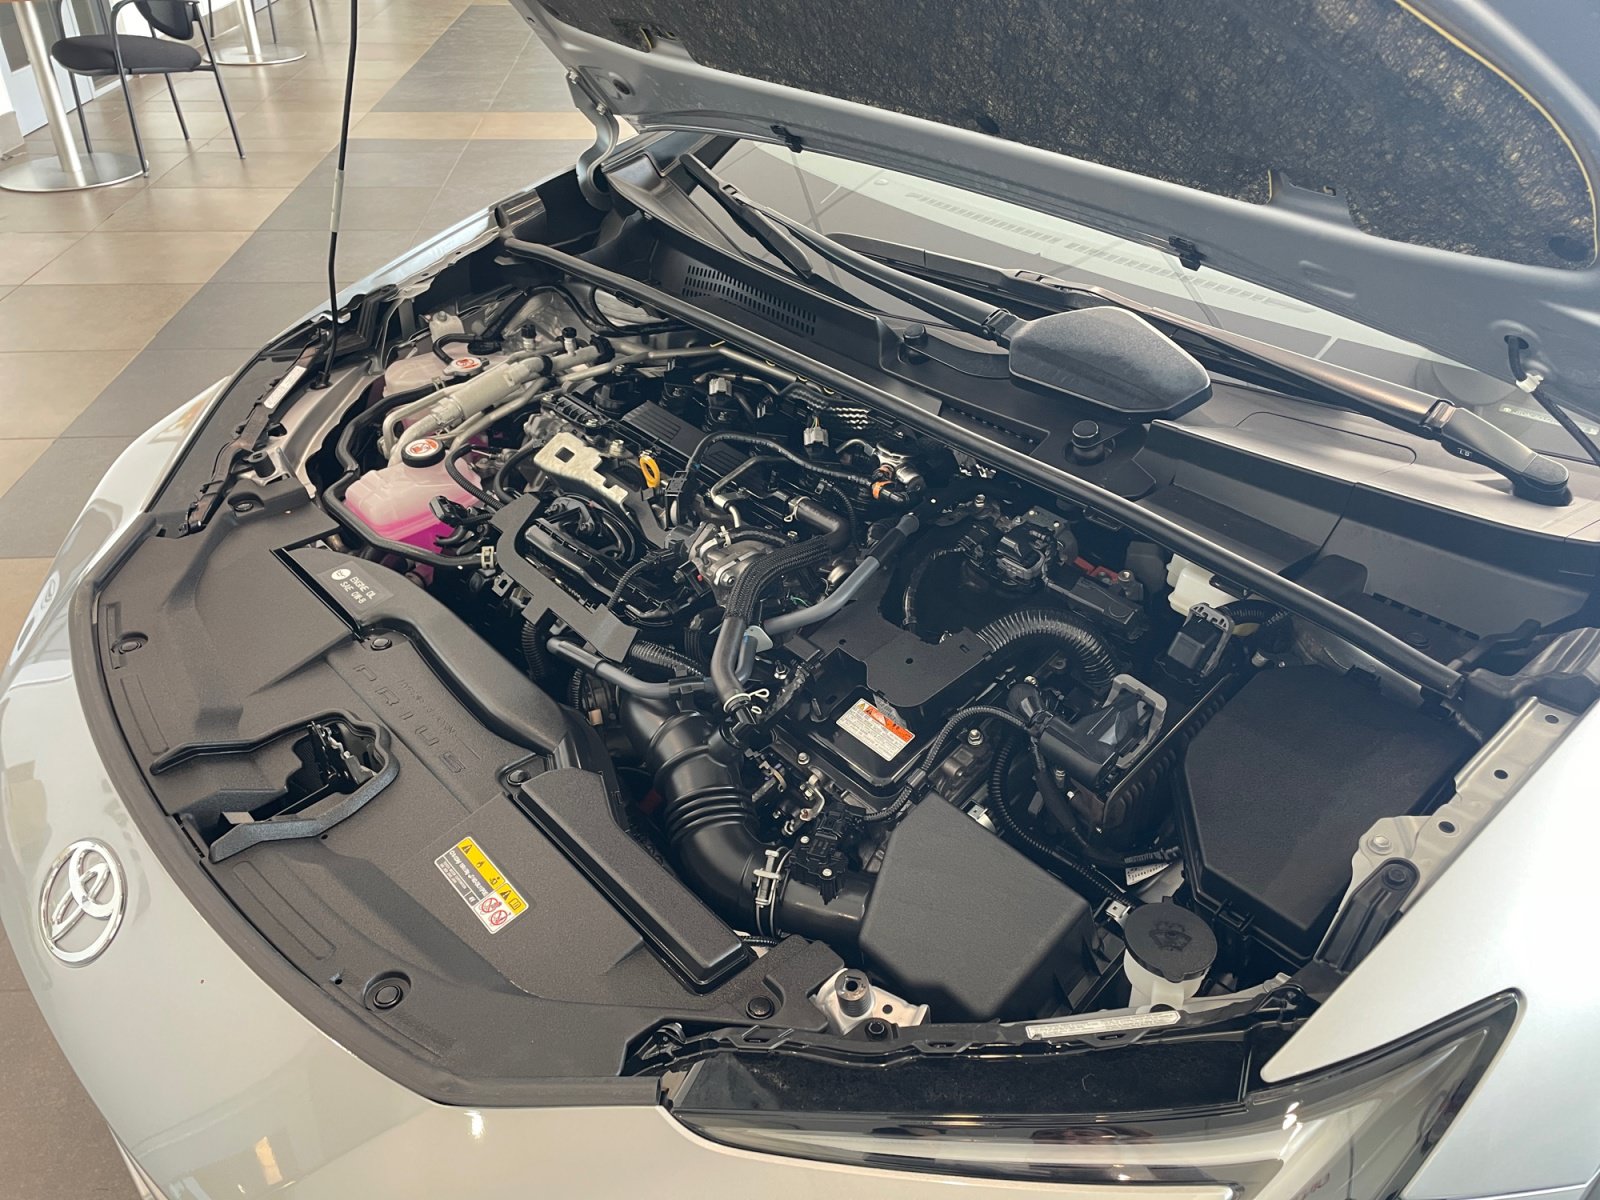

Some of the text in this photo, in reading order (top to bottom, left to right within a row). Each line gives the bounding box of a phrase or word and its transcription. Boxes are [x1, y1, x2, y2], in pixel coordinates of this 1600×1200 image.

[340, 581, 355, 593] SAE
[350, 576, 377, 600] ENGINE OIL
[353, 664, 466, 774] PRIUS
